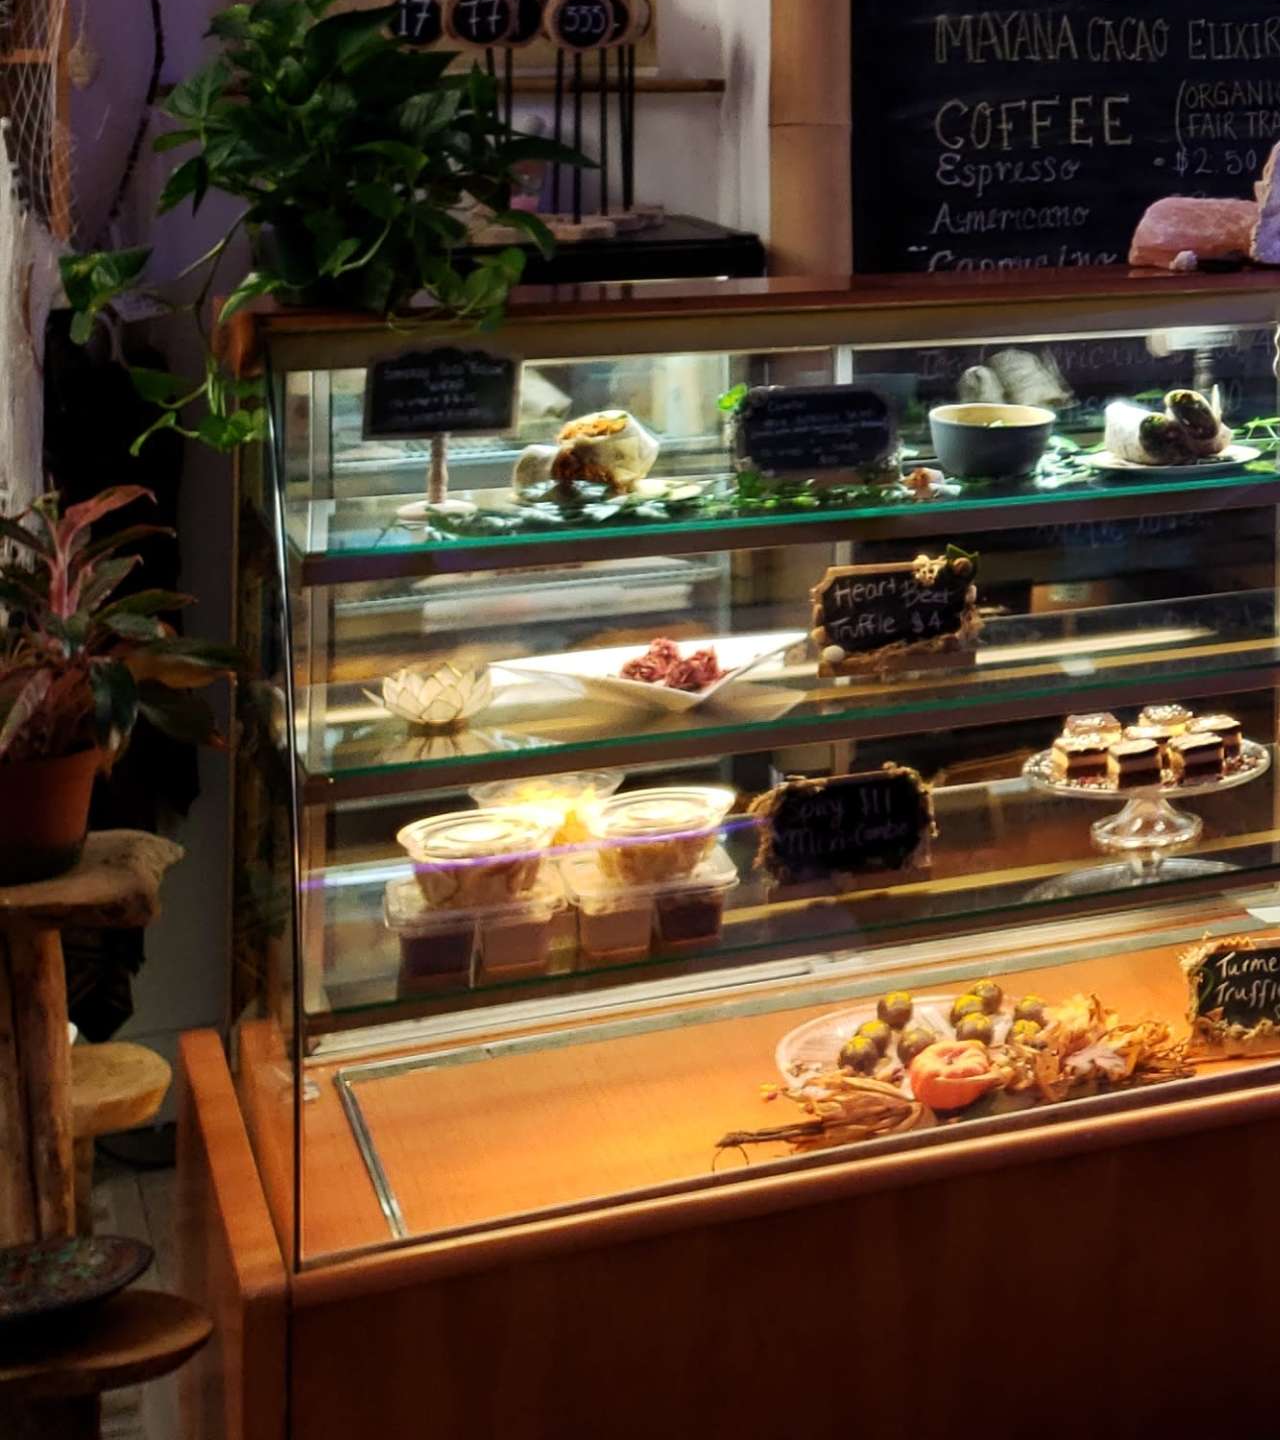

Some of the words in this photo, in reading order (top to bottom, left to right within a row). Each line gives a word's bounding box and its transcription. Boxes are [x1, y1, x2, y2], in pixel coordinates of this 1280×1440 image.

[1087, 16, 1170, 62] CACAO
[935, 92, 1134, 151] COFFEE
[1185, 112, 1239, 141] FAIR
[936, 152, 1082, 198] Espresso
[930, 201, 1090, 234] Americano
[834, 576, 896, 607] Heart
[829, 614, 895, 640] Truffle
